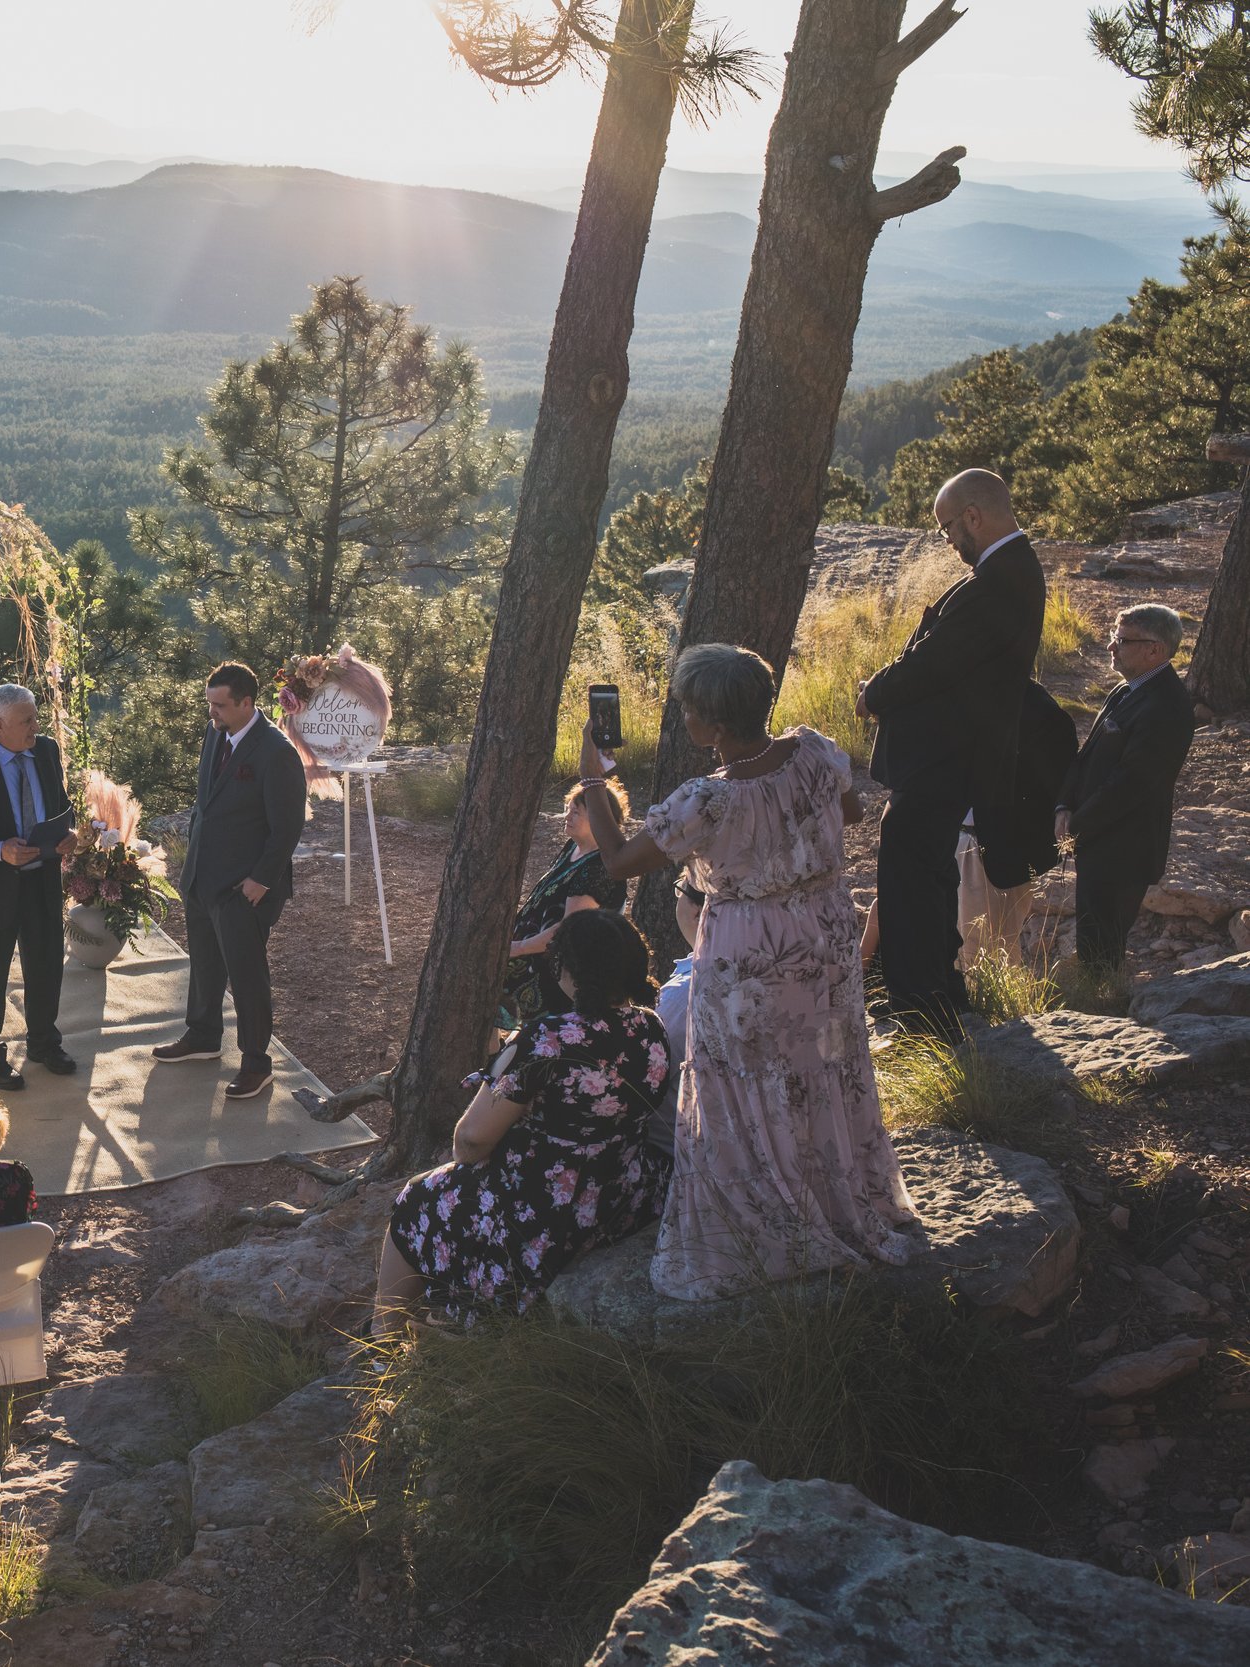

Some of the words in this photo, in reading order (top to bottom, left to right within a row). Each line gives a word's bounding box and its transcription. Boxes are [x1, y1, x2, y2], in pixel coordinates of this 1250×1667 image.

[307, 688, 367, 712] Welcom
[318, 712, 333, 723] TO
[335, 713, 359, 724] OUR
[302, 722, 375, 736] BEGINNING
